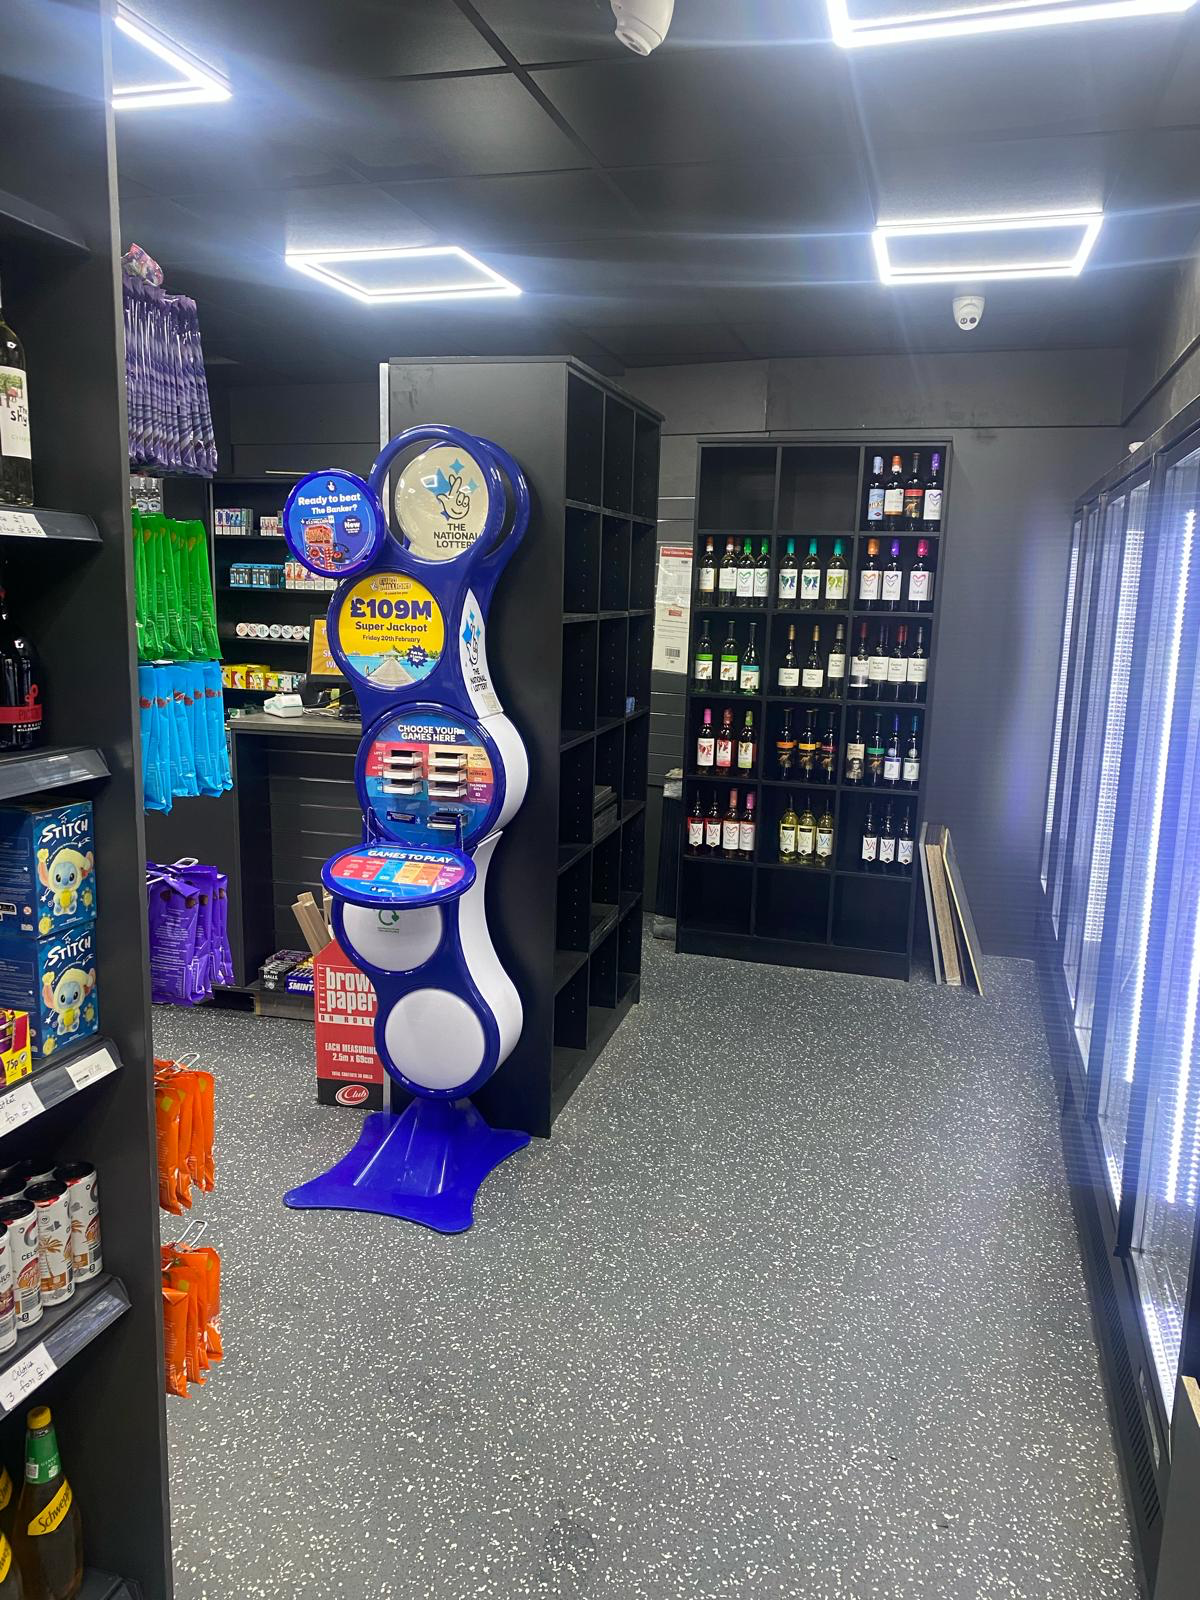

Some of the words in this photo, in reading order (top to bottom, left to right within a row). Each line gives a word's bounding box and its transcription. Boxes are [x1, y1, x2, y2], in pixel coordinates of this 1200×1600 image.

[298, 496, 327, 506] Ready
[329, 495, 338, 503] to
[339, 493, 361, 502] beat
[311, 507, 325, 515] The
[326, 504, 358, 513] Banker?
[344, 521, 361, 529] New
[447, 523, 467, 532] THE
[436, 541, 475, 550] LOTTER
[350, 598, 432, 621] £109M
[355, 621, 385, 632] Super
[386, 622, 428, 633] Jackpot
[362, 635, 381, 643] Friday
[395, 635, 421, 643] February
[470, 675, 487, 685] NATIONAL
[474, 682, 489, 693] LOTTERY
[398, 724, 434, 734] CHOOSE
[436, 726, 461, 735] YOUR
[401, 733, 432, 742] GAMES
[433, 733, 456, 743] HERE
[42, 818, 89, 843] STITCH
[368, 850, 408, 860] GAMES
[408, 853, 424, 861] TO
[424, 855, 454, 865] PLAY
[47, 936, 91, 967] STITCH
[326, 991, 377, 1014] paper
[324, 1042, 341, 1052] EACH
[332, 1052, 349, 1062] 2.5m
[349, 1055, 355, 1063] x
[6, 1059, 19, 1071] 75p
[343, 1087, 367, 1099] Club
[6, 1392, 15, 1403] 3
